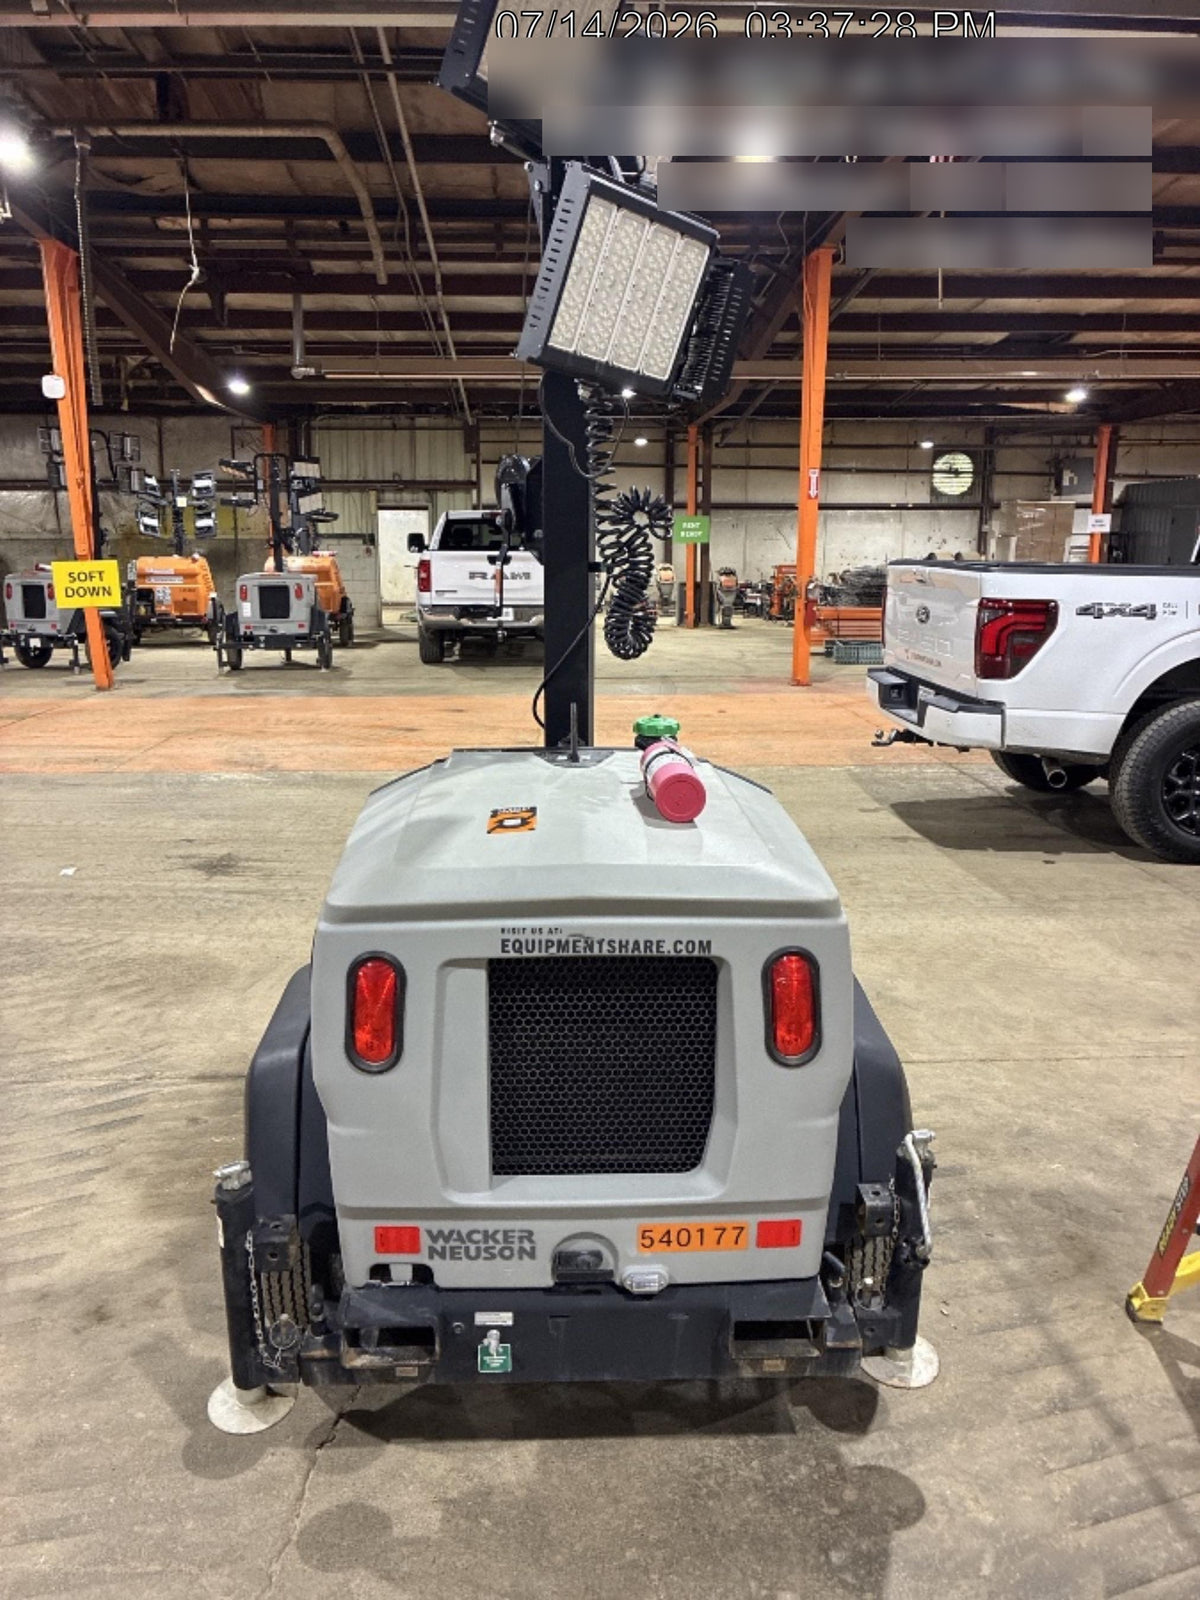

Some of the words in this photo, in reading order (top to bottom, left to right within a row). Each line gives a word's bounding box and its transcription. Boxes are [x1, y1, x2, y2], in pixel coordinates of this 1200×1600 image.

[68, 570, 104, 583] SOFT
[65, 586, 112, 598] DOWN
[501, 938, 712, 955] EQUIPMENTSHARE.COM
[425, 1229, 536, 1245] WACKER
[640, 1226, 745, 1249] 540177
[428, 1245, 536, 1261] NEUSON
